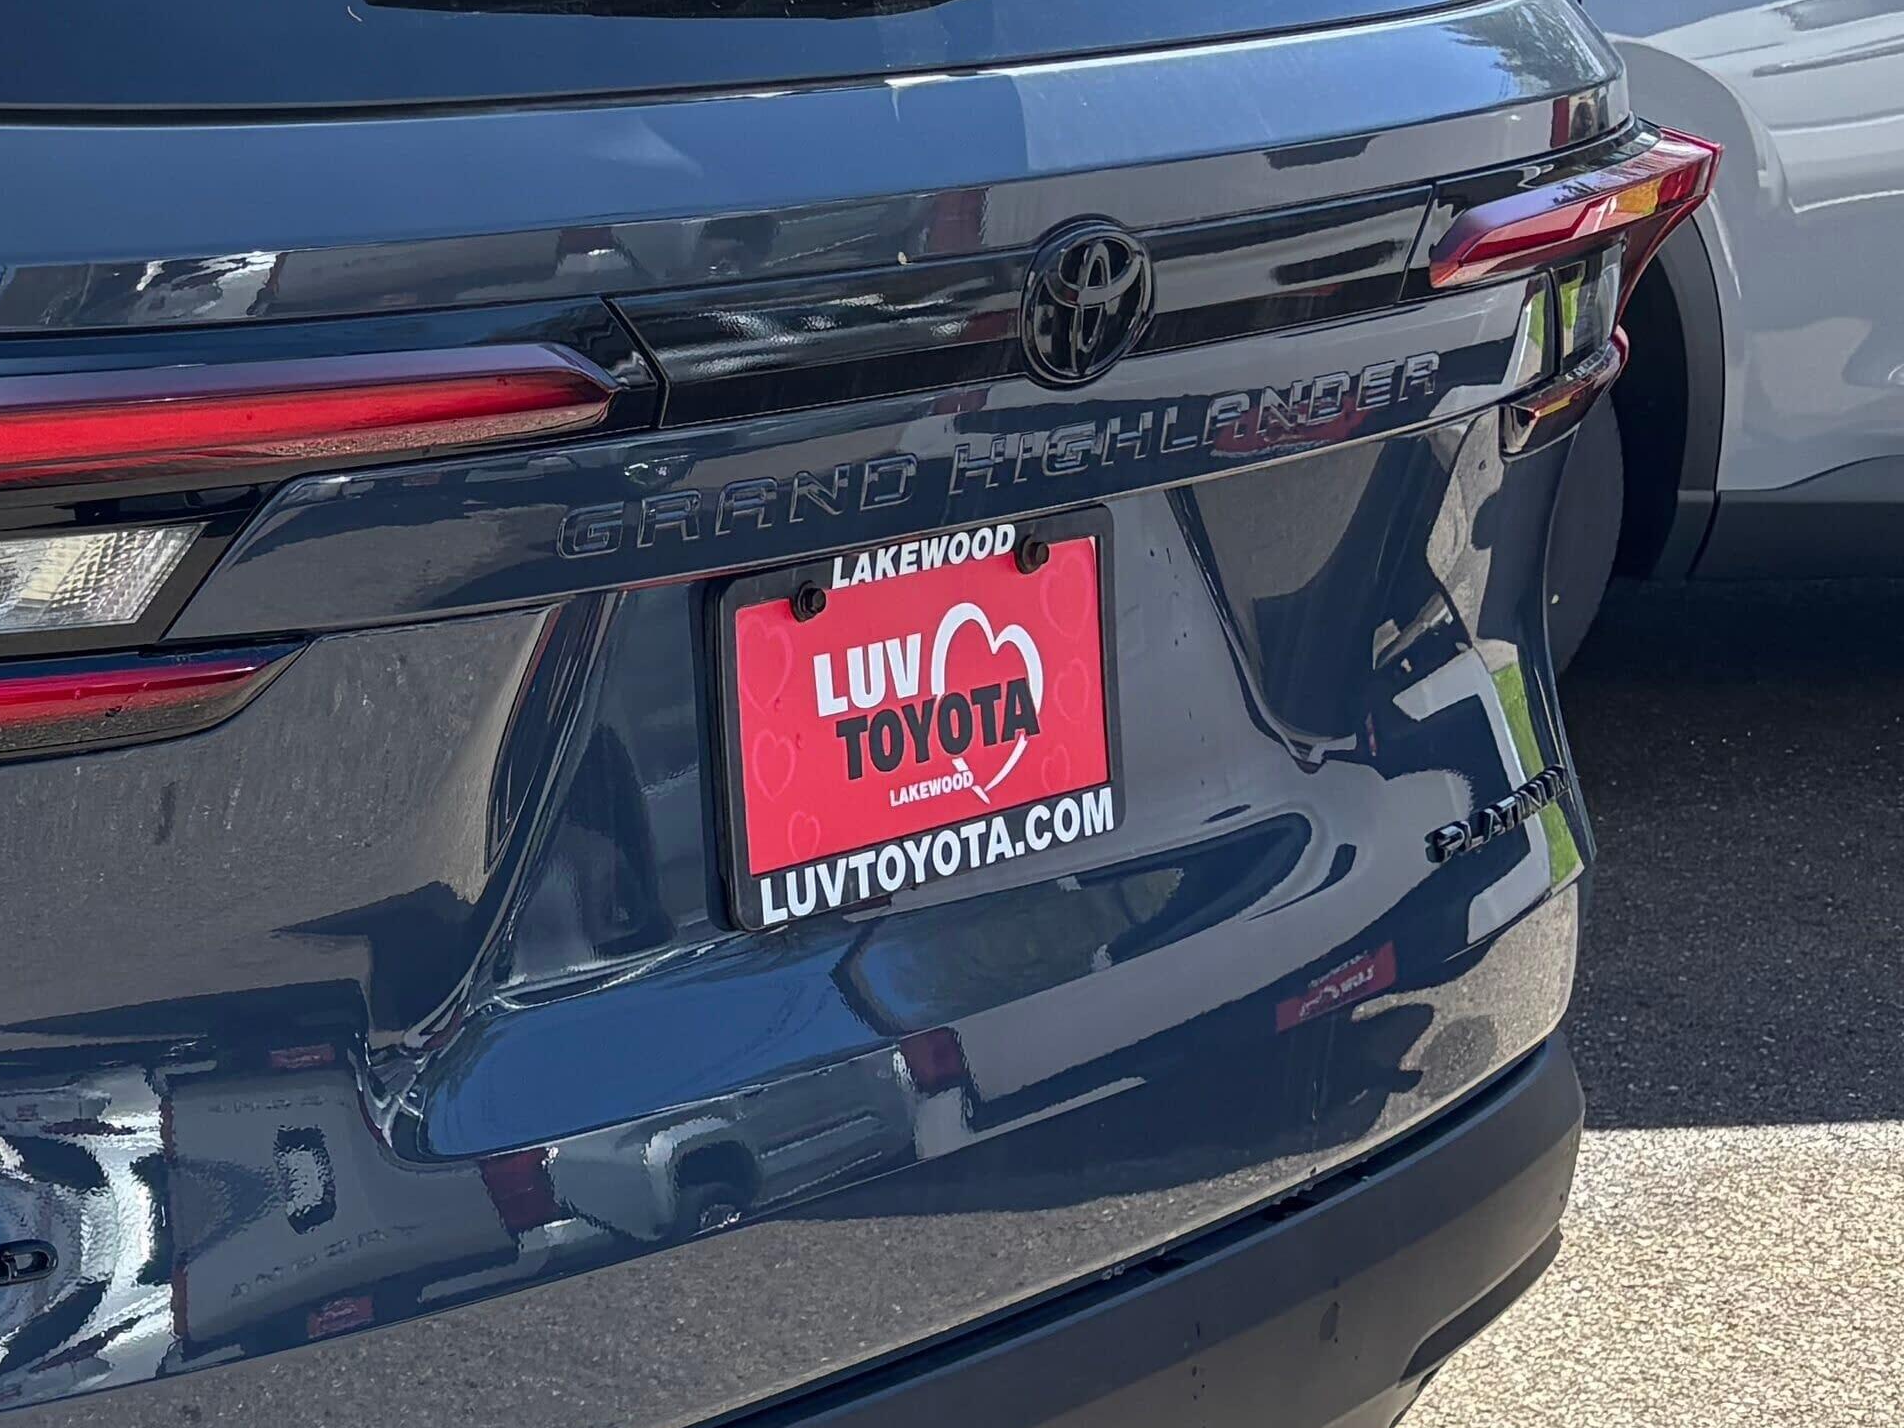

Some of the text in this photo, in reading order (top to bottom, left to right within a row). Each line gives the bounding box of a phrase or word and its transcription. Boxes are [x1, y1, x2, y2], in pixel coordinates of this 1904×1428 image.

[556, 351, 1441, 561] GRAND HIGHLANDER
[830, 523, 1017, 590] LAKEWOOD
[812, 632, 922, 717] LUV
[835, 677, 1041, 781] TOYOTA
[889, 770, 975, 808] LAKEWOOD
[758, 786, 1115, 926] LUVTOYOTA.COM
